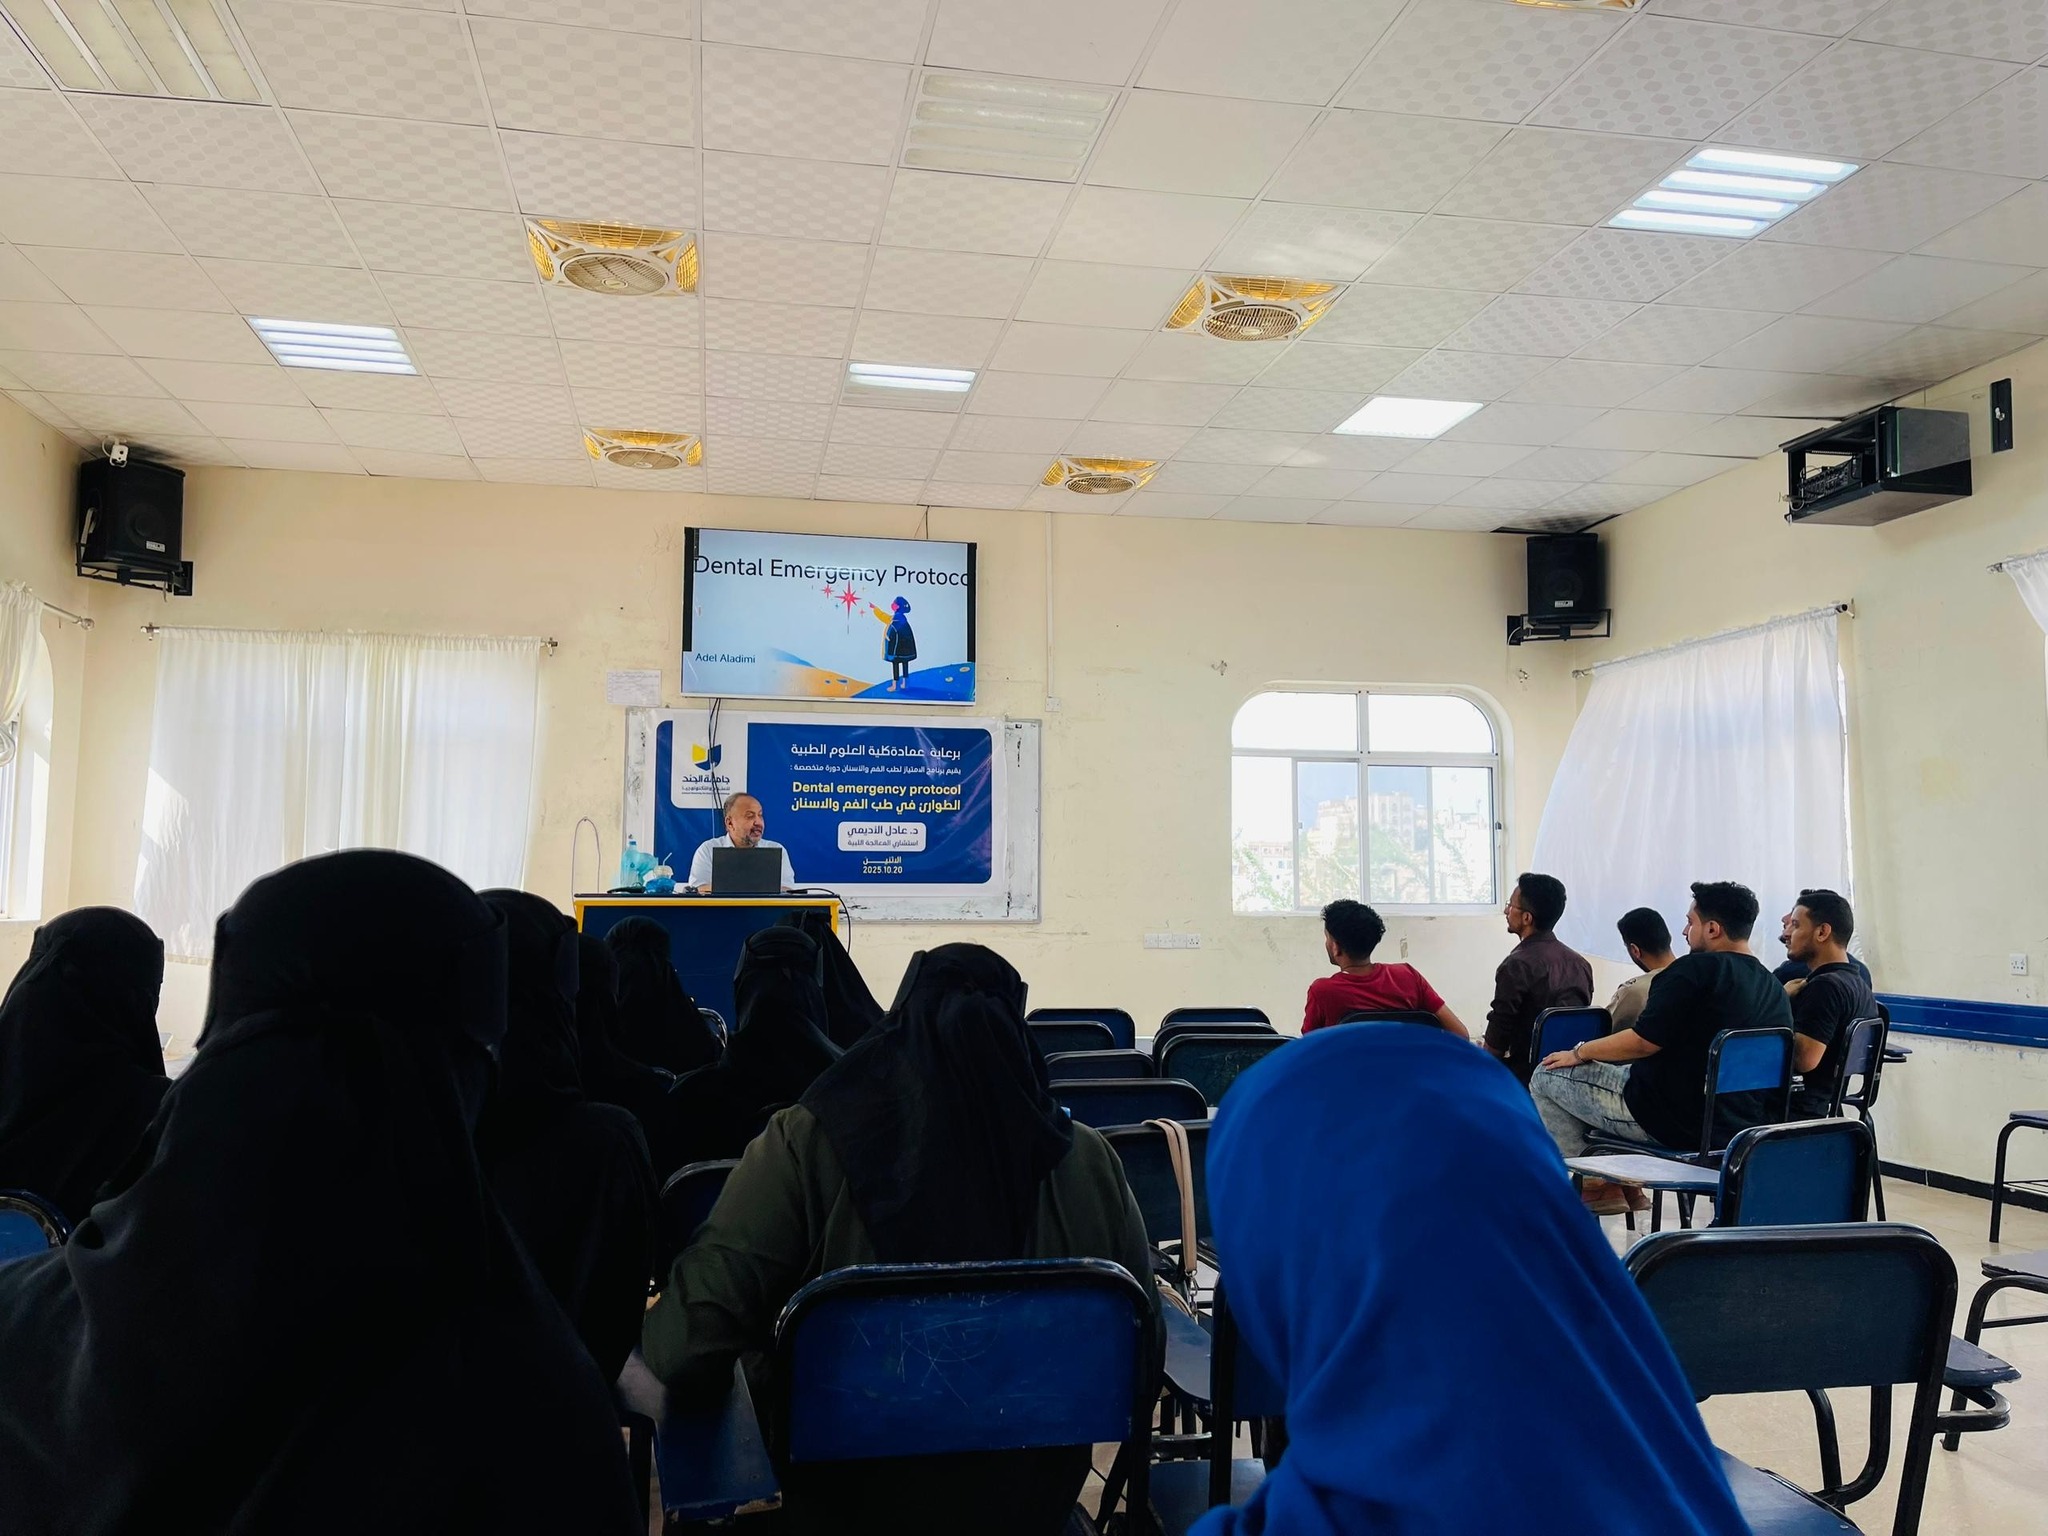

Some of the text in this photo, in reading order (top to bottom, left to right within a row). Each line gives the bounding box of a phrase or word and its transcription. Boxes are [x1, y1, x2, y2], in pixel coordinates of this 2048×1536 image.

[694, 555, 763, 577] Dental
[770, 559, 887, 587] Emergency
[695, 653, 756, 664] Adel Aladimi
[791, 743, 826, 756] الطبية
[829, 744, 865, 758] العلوم
[930, 746, 961, 760] برعاية
[793, 763, 824, 772] متخصصة
[825, 764, 841, 773] دورة
[870, 764, 885, 774] الفم
[886, 765, 902, 774] لطب
[926, 767, 945, 776] برنامج
[681, 773, 704, 785] الجند
[792, 781, 961, 797] Dental emergency protocol
[842, 798, 868, 812] الفم
[871, 799, 893, 812] طب
[895, 799, 917, 815] في
[885, 825, 908, 836] عادل
[862, 866, 903, 874] 2025.10.20
